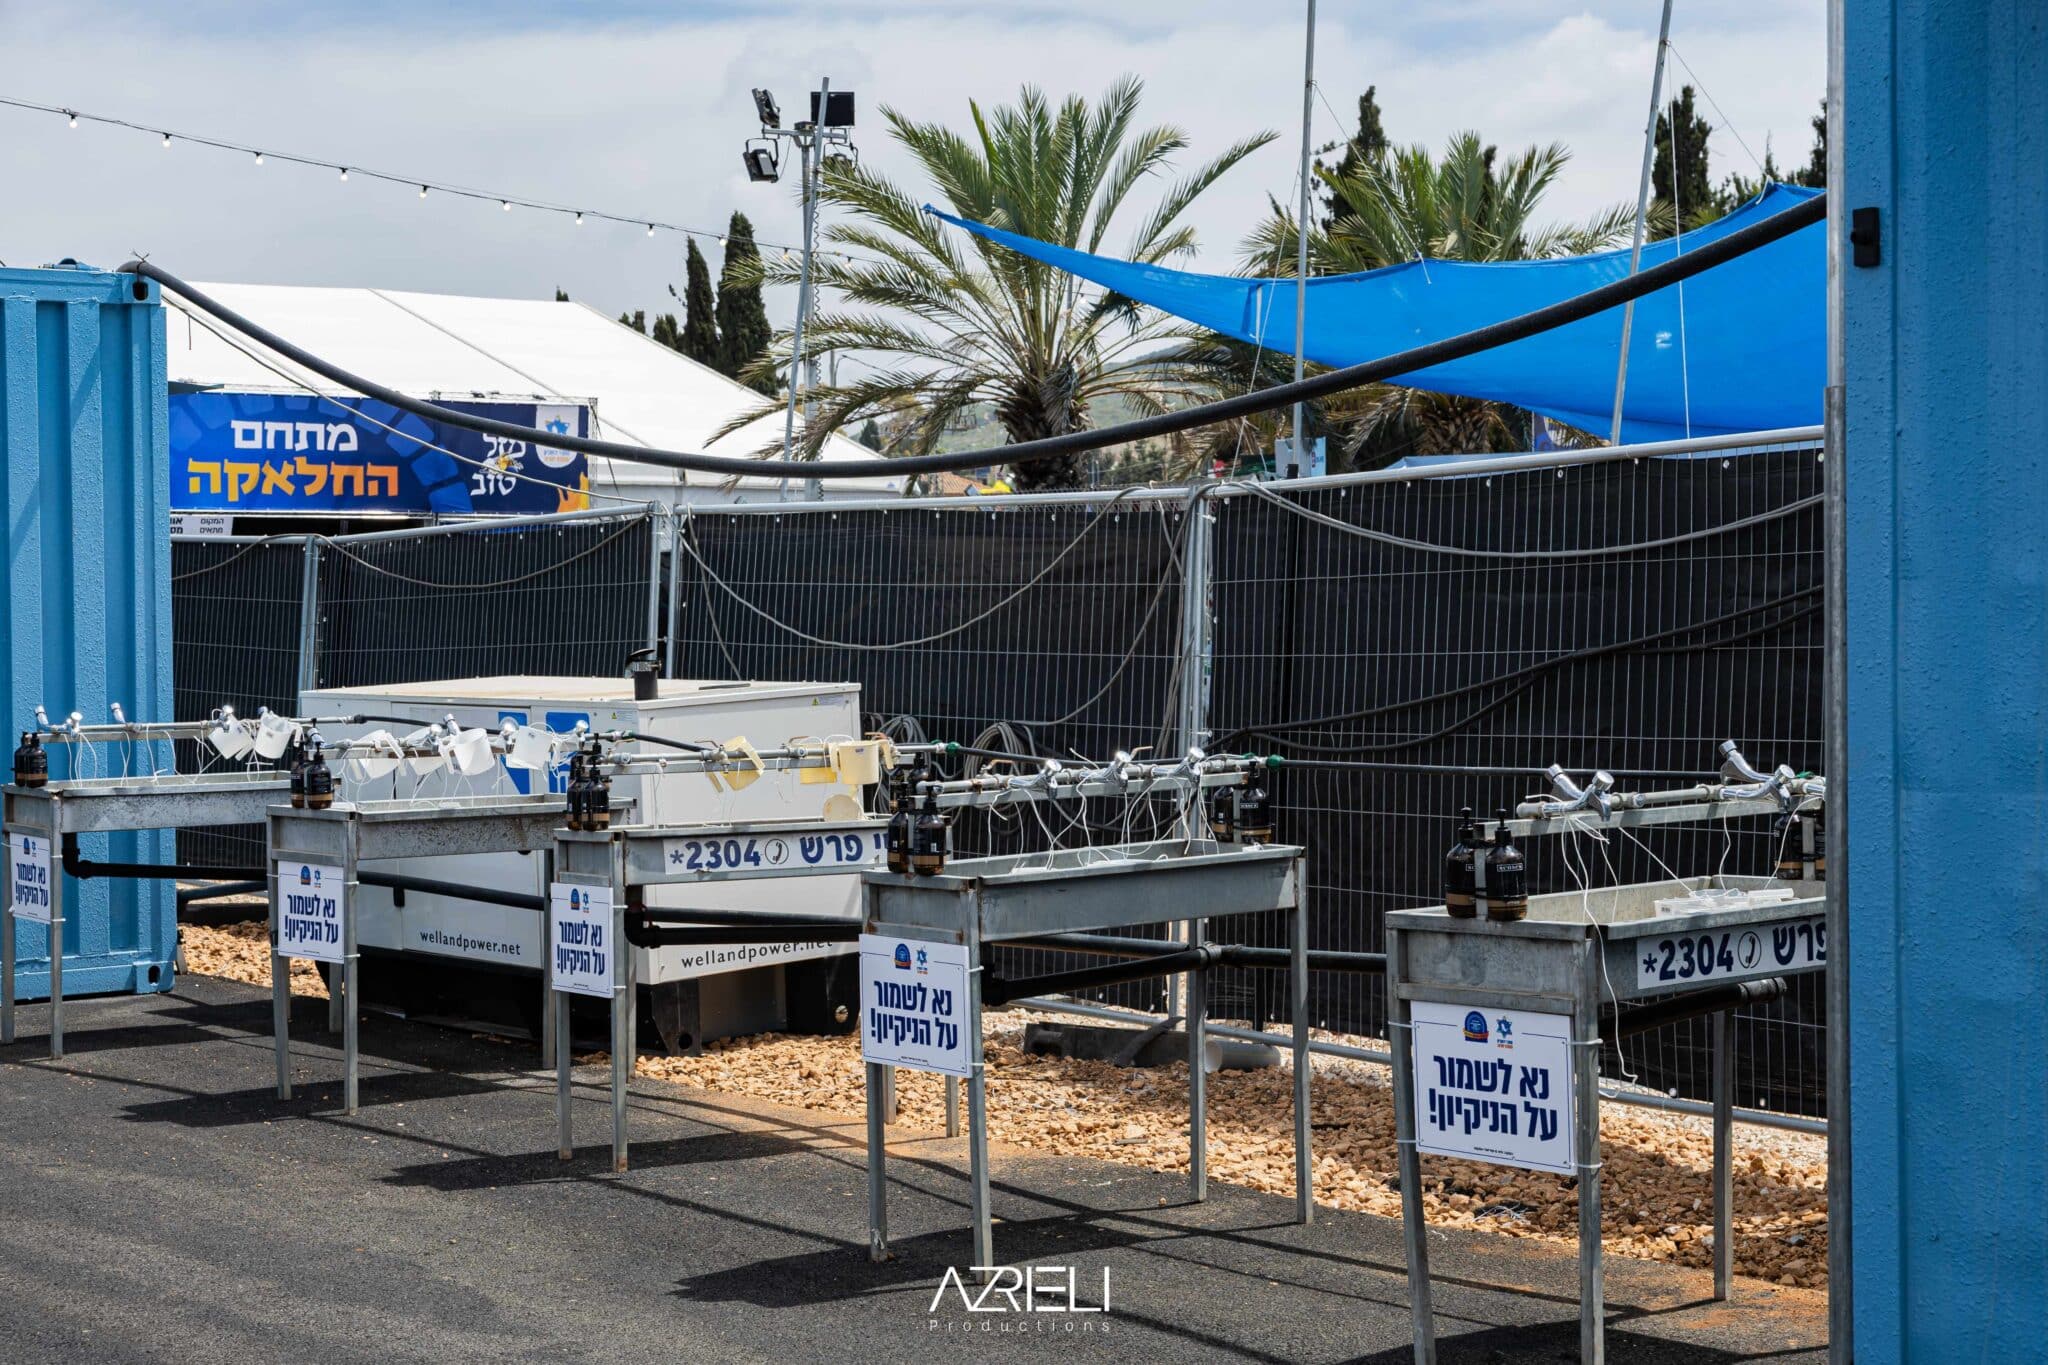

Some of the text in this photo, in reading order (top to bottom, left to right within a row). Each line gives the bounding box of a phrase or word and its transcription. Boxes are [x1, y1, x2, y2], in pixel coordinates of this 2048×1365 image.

[231, 420, 358, 451] מתחם
[482, 432, 526, 458] מזל
[187, 456, 399, 502] החלאקה
[470, 473, 517, 496] טוב
[800, 834, 863, 864] פרש
[16, 862, 46, 884] נא לשמור
[39, 886, 48, 907] על
[287, 894, 335, 918] נא לשמור
[285, 915, 338, 944] על הניקיון!
[420, 930, 520, 955] wellandpower.net
[559, 920, 602, 947] נא לשמור
[557, 944, 605, 976] על הניקיון!
[874, 980, 952, 1016] נא לשמור
[870, 1008, 957, 1050] על הניקיון!
[1433, 1055, 1549, 1100] נא לשמור
[1429, 1088, 1558, 1142] על הניקיון!
